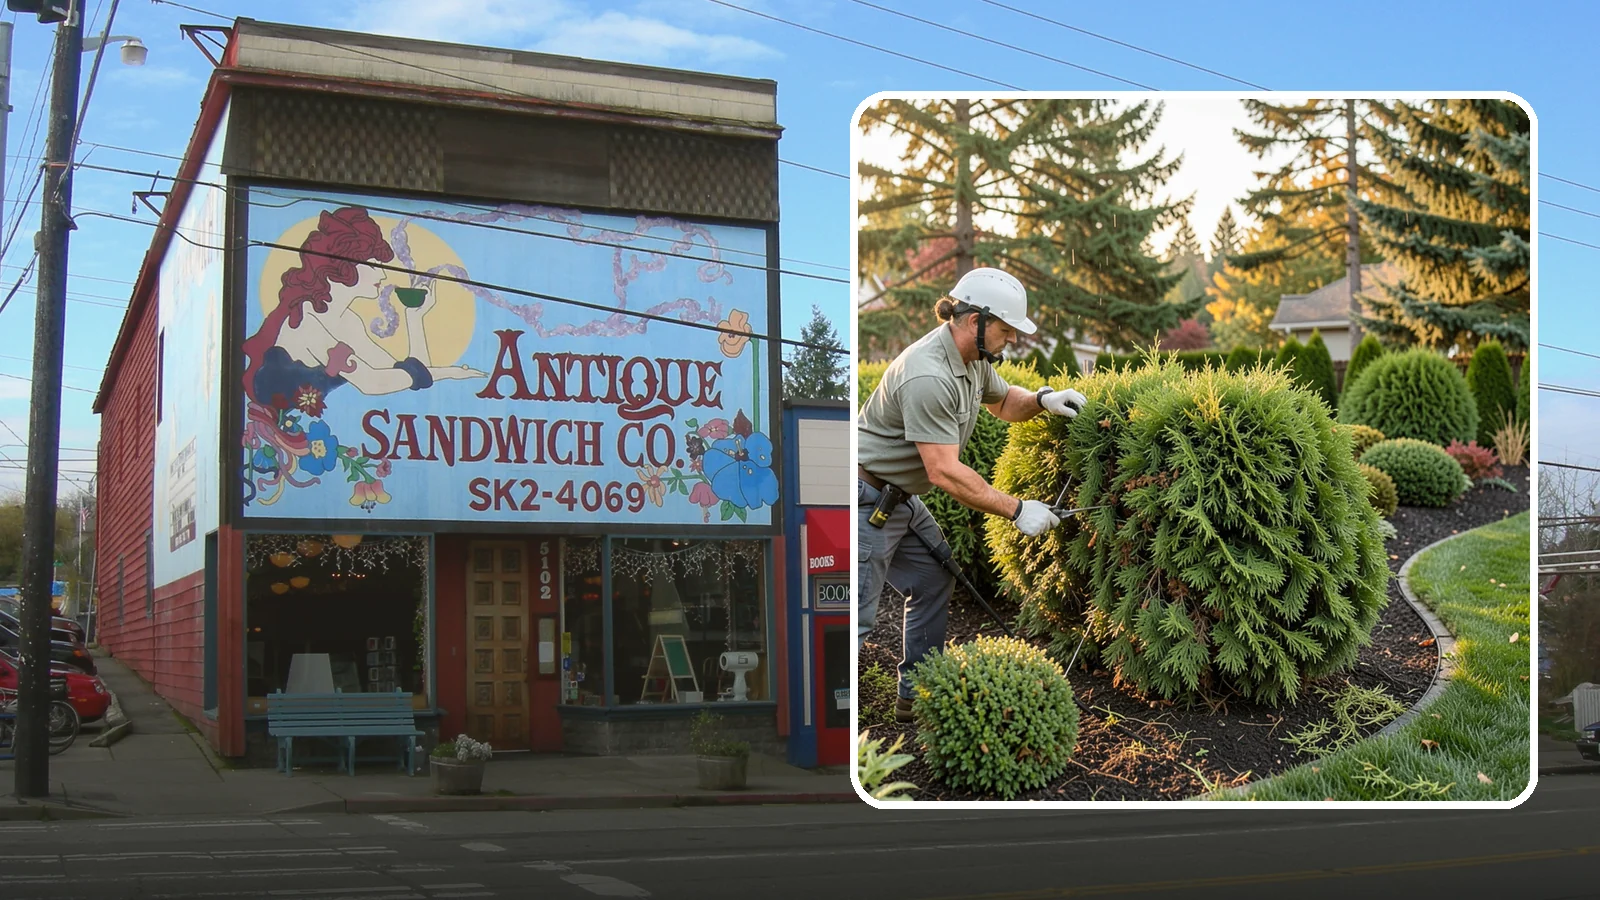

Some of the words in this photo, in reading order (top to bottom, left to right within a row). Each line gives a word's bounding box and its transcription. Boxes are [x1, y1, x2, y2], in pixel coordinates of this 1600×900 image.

[476, 329, 723, 420] ANTIQUE
[362, 408, 604, 467] SANDWICH
[617, 422, 685, 468] CO.
[468, 477, 646, 513] SK2-4069
[540, 541, 552, 600] 5102
[809, 555, 835, 569] BOOKS
